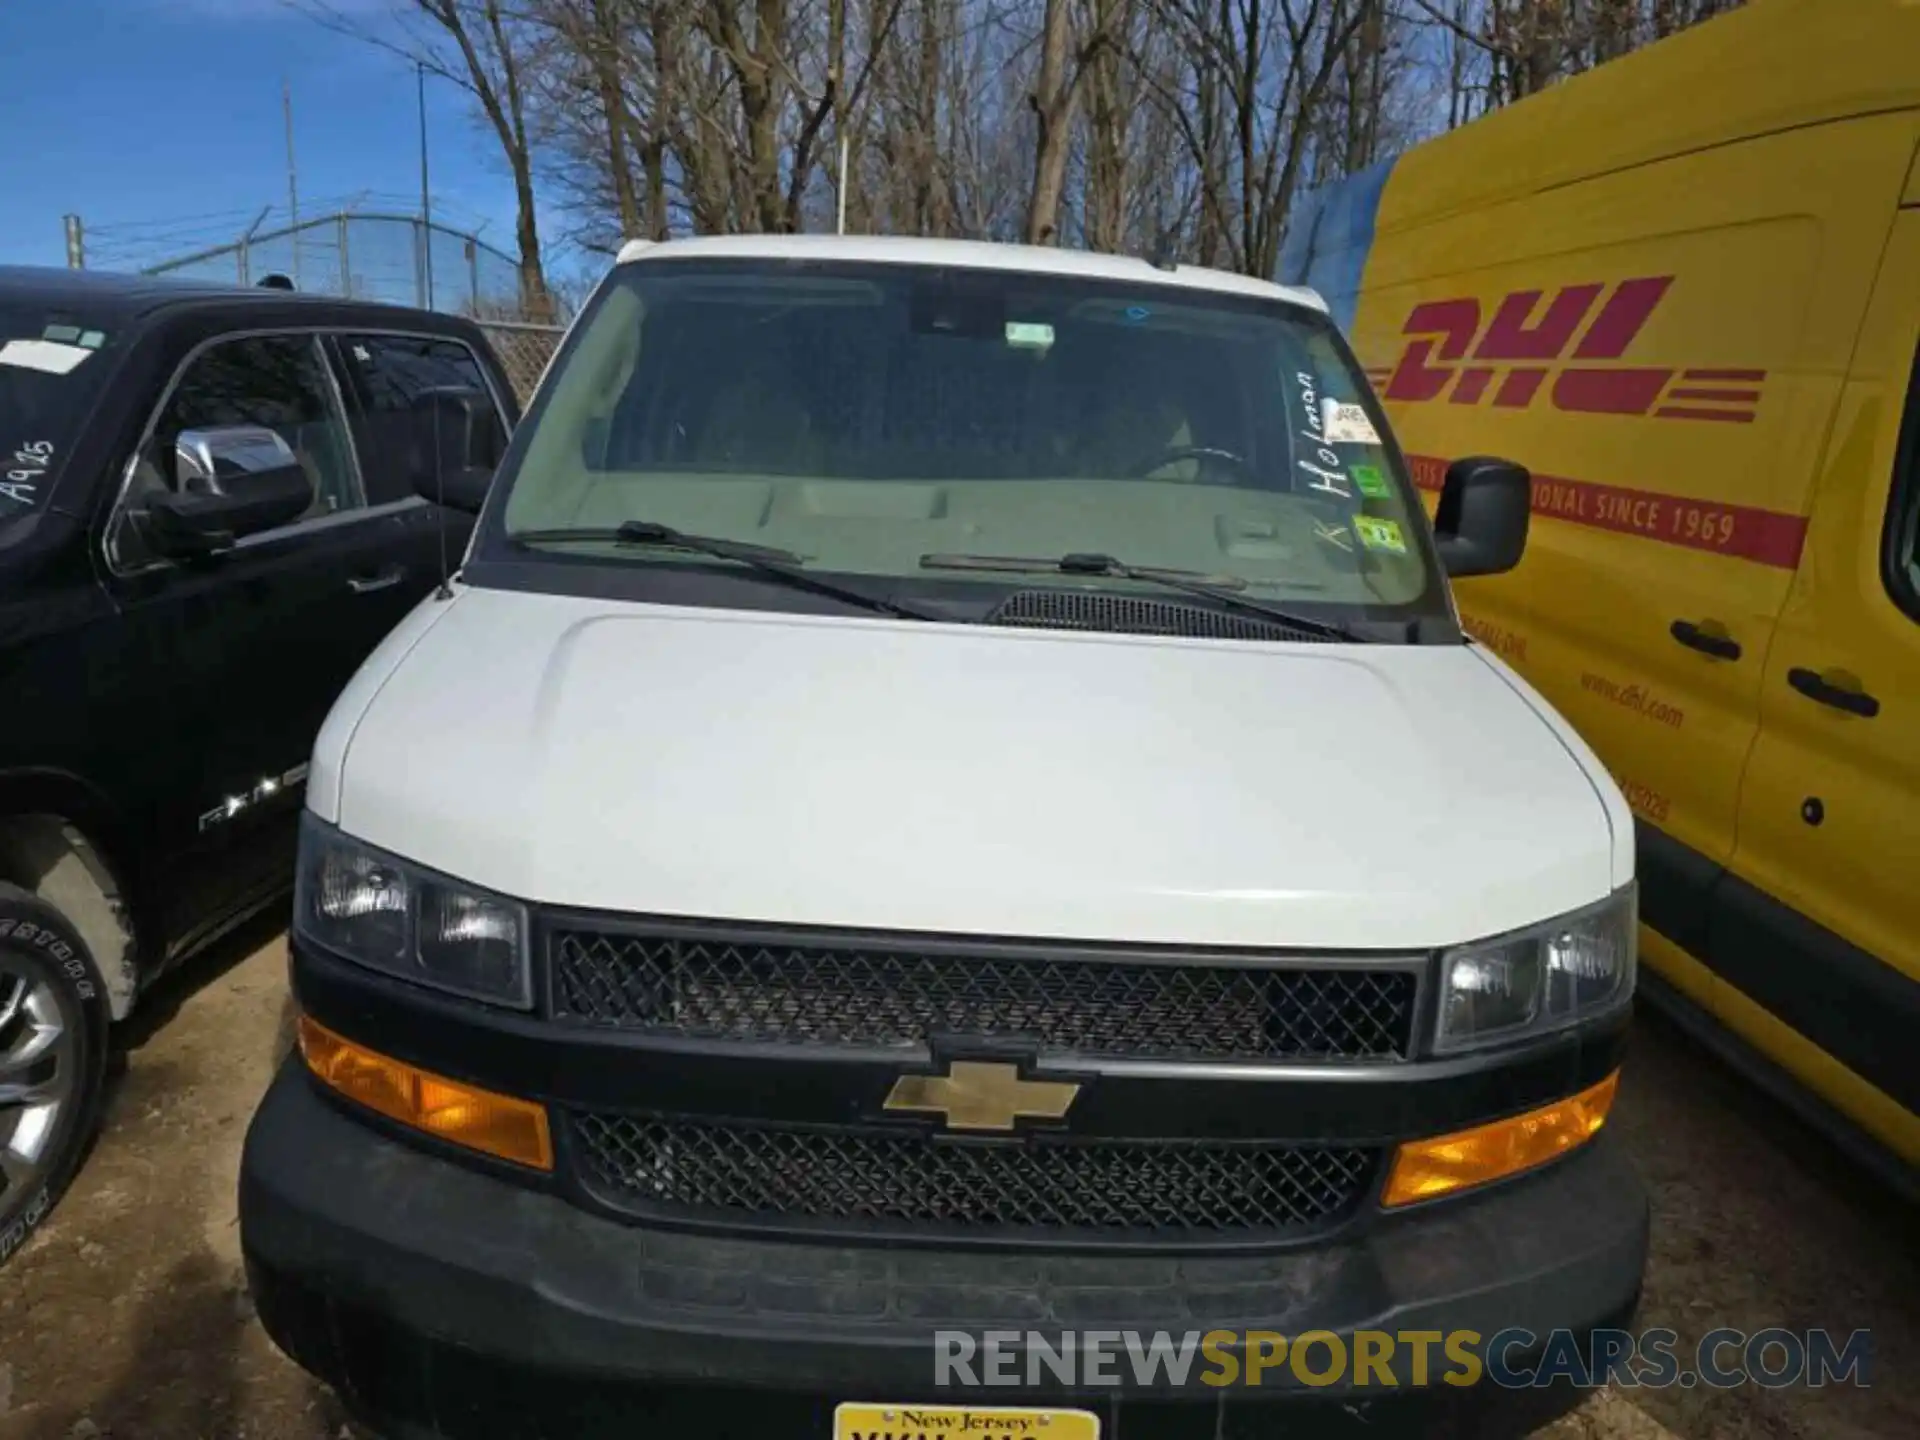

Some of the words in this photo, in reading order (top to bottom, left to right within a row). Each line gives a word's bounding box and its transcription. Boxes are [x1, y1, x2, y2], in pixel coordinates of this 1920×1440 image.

[1384, 275, 1675, 418] DHL
[1296, 371, 1353, 499] Holman
[1532, 482, 1586, 517] IONAL
[1596, 493, 1661, 531] SINCE
[1671, 506, 1735, 545] 1969
[1580, 671, 1685, 730] www.dhl.com
[901, 1410, 957, 1429] New
[958, 1412, 1034, 1433] Jersey
